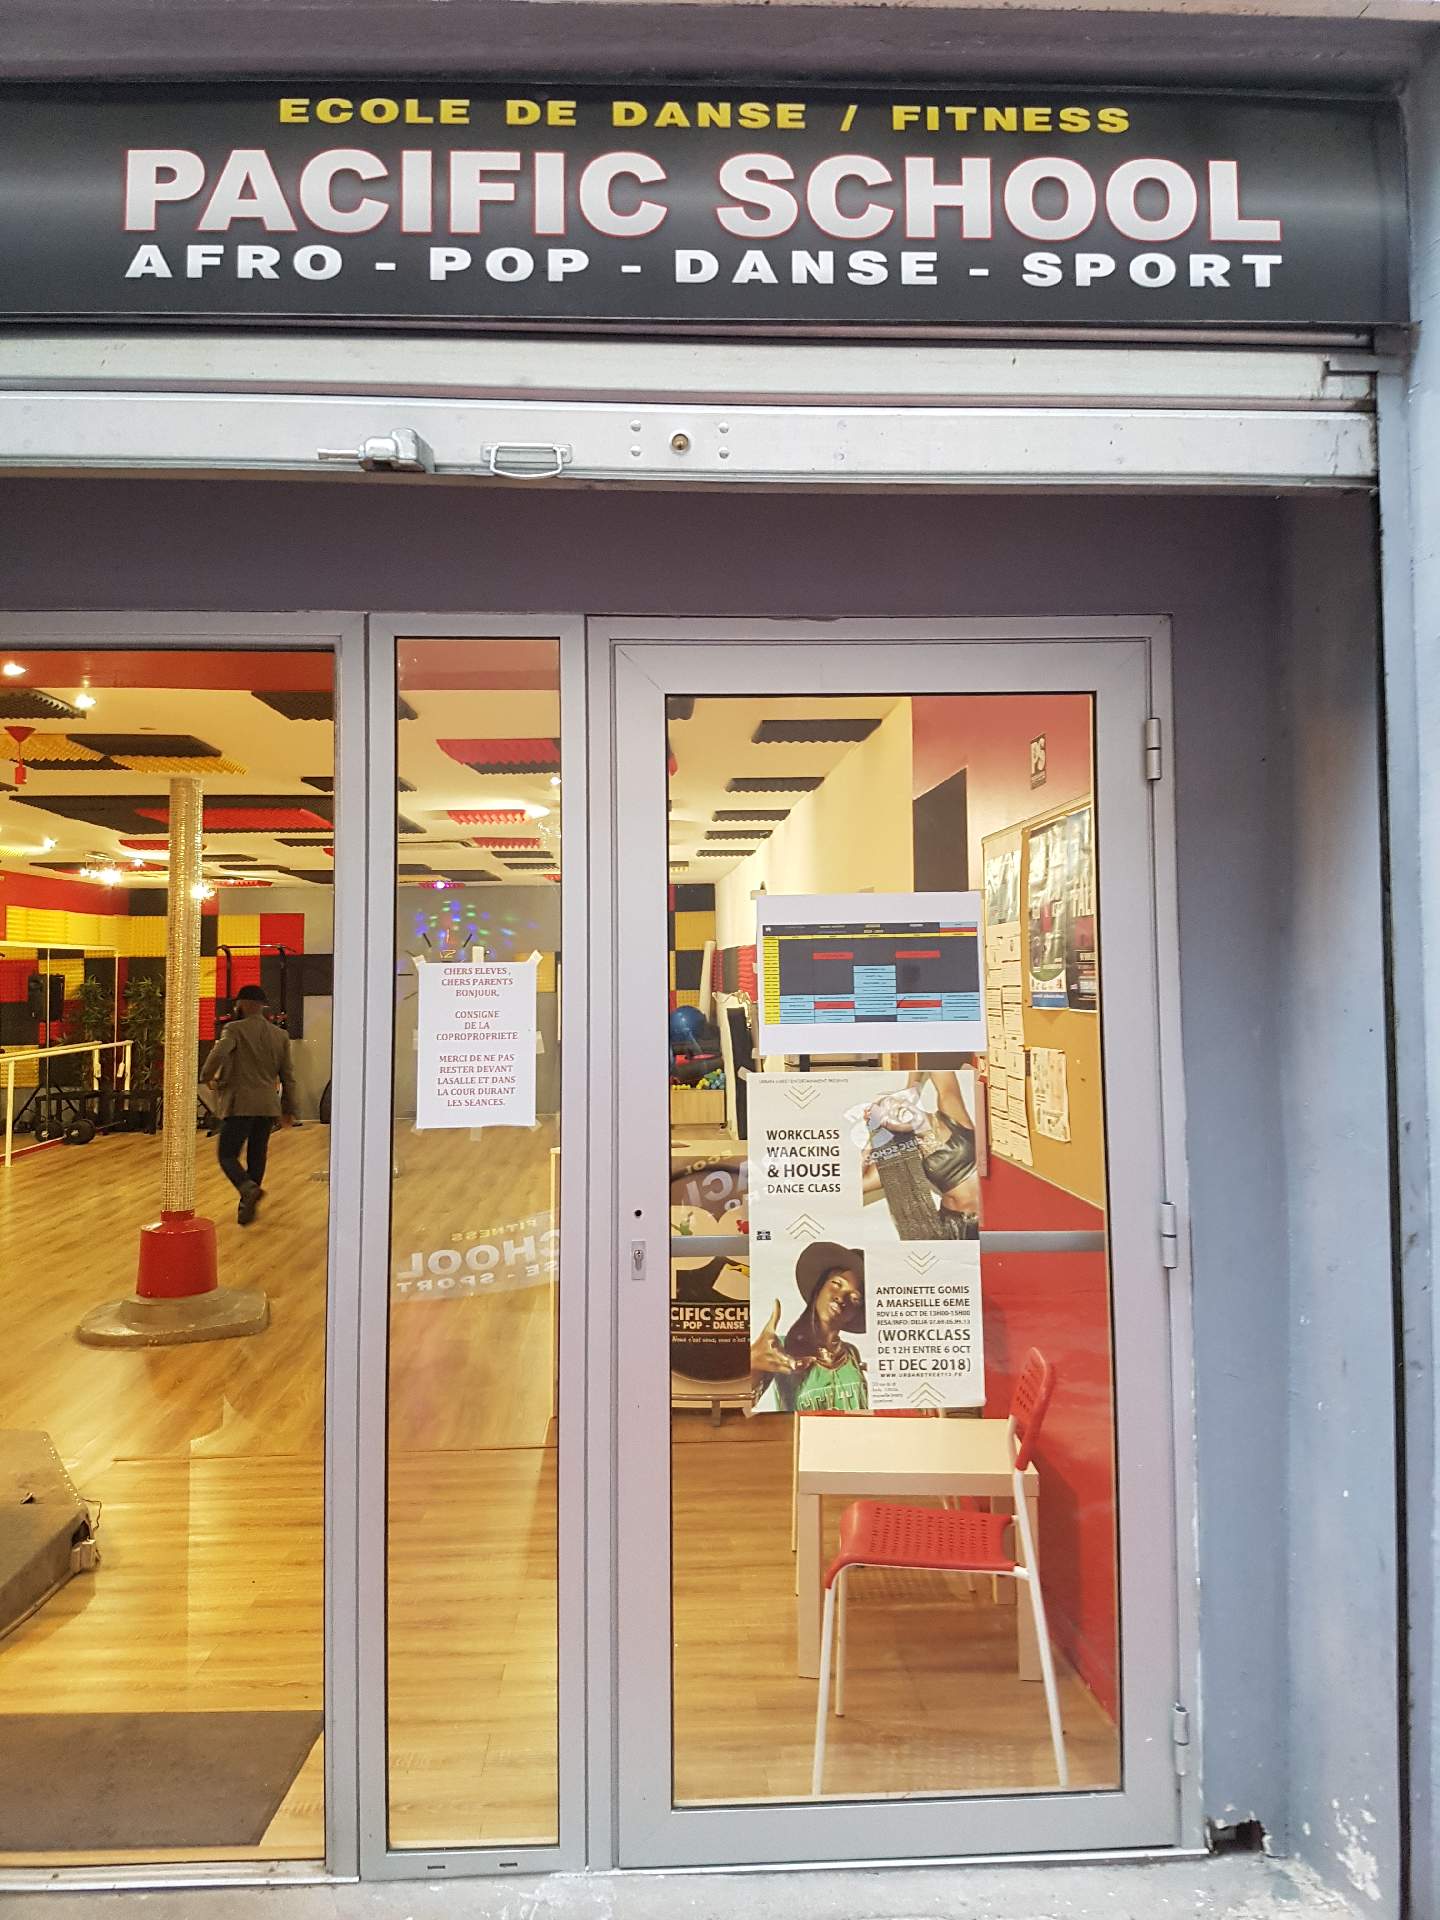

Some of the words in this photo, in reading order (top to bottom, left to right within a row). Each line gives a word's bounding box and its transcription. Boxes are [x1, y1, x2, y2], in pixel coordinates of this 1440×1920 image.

[279, 97, 471, 125] ECOLE
[506, 100, 577, 127] DE
[612, 101, 806, 129] DANSE
[840, 104, 858, 132] /
[892, 105, 1130, 134] FITNESS
[123, 146, 669, 237] PACIFIC
[715, 152, 1282, 242] SCHOOL
[125, 244, 343, 280] AFRO
[429, 247, 590, 283] POP
[675, 249, 937, 286] DANSE
[1022, 252, 1283, 288] SPORT
[443, 967, 473, 975] CHERS
[441, 978, 471, 986] CHERS
[472, 977, 513, 986] PARENTS
[455, 1010, 501, 1019] CONSIGNE
[464, 1021, 477, 1030] DE
[478, 1021, 490, 1030] LA
[439, 1054, 467, 1063] MERCI
[469, 1054, 482, 1062] DE
[483, 1054, 496, 1062] NE
[498, 1053, 515, 1062] PAS
[439, 1065, 474, 1074] RESTER
[476, 1064, 513, 1073] DEVANT
[478, 1076, 489, 1084] ET
[491, 1075, 517, 1084] DANS
[437, 1088, 449, 1096] LA
[450, 1087, 476, 1096] COUR
[477, 1086, 516, 1095] DURANT
[447, 1099, 462, 1107] LES
[766, 1129, 840, 1141] WORKCLASS
[766, 1145, 840, 1158] WAACKING
[767, 1163, 779, 1178] &
[784, 1163, 841, 1178] HOUSE
[767, 1183, 805, 1194] DANCE
[807, 1183, 841, 1193] CLASS
[876, 1286, 936, 1295] ANTOINETTE
[937, 1285, 970, 1294] GOMIS
[876, 1299, 884, 1308] A
[886, 1298, 941, 1308] MARSEILLE
[942, 1298, 971, 1307] 6EME
[682, 1321, 703, 1330] POP
[712, 1321, 745, 1330] DANSE
[878, 1328, 971, 1344] (WORKCLASS
[878, 1346, 891, 1354] DE
[892, 1346, 911, 1354] 12H
[912, 1346, 942, 1354] ENTRE
[944, 1346, 950, 1354] 6
[952, 1345, 972, 1354] OCT
[878, 1359, 895, 1371] ET
[899, 1359, 928, 1371] DEC
[931, 1358, 971, 1373] 2018)
